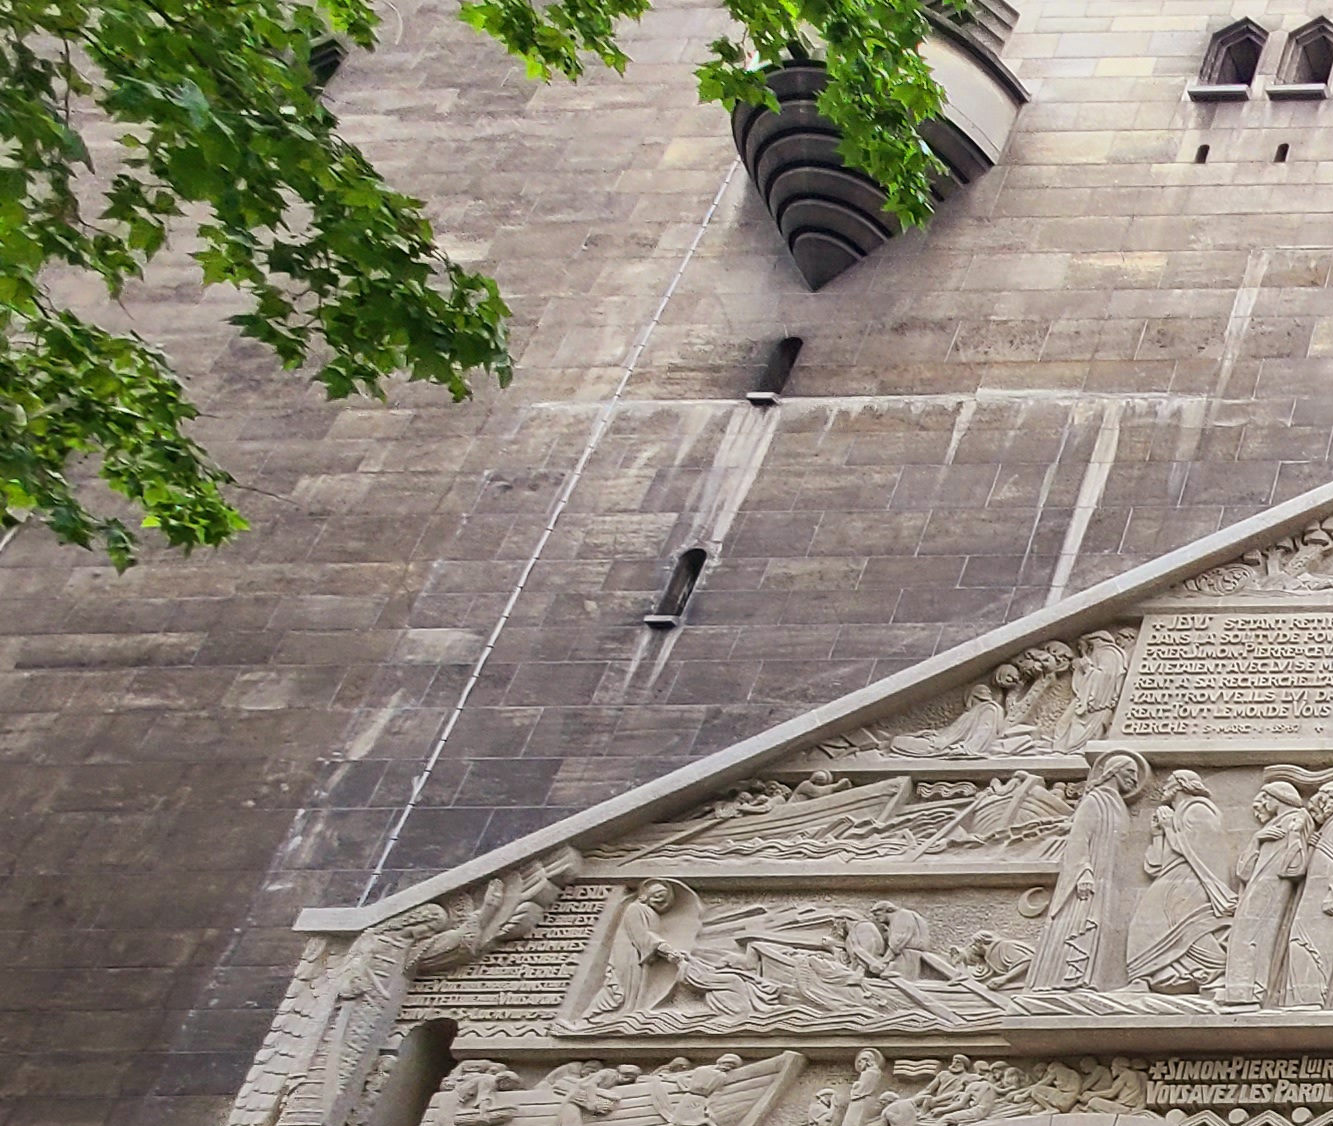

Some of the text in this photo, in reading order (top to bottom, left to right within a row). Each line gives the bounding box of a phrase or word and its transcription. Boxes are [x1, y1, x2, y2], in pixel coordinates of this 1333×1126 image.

[1147, 632, 1191, 646] DANS
[1193, 632, 1216, 646] LA
[1220, 632, 1301, 645] SOLITVDE
[1226, 661, 1268, 674] AVEC
[1233, 704, 1291, 719] MONDE
[1192, 1084, 1239, 1104] AVEZ
[1238, 1083, 1274, 1103] LES
